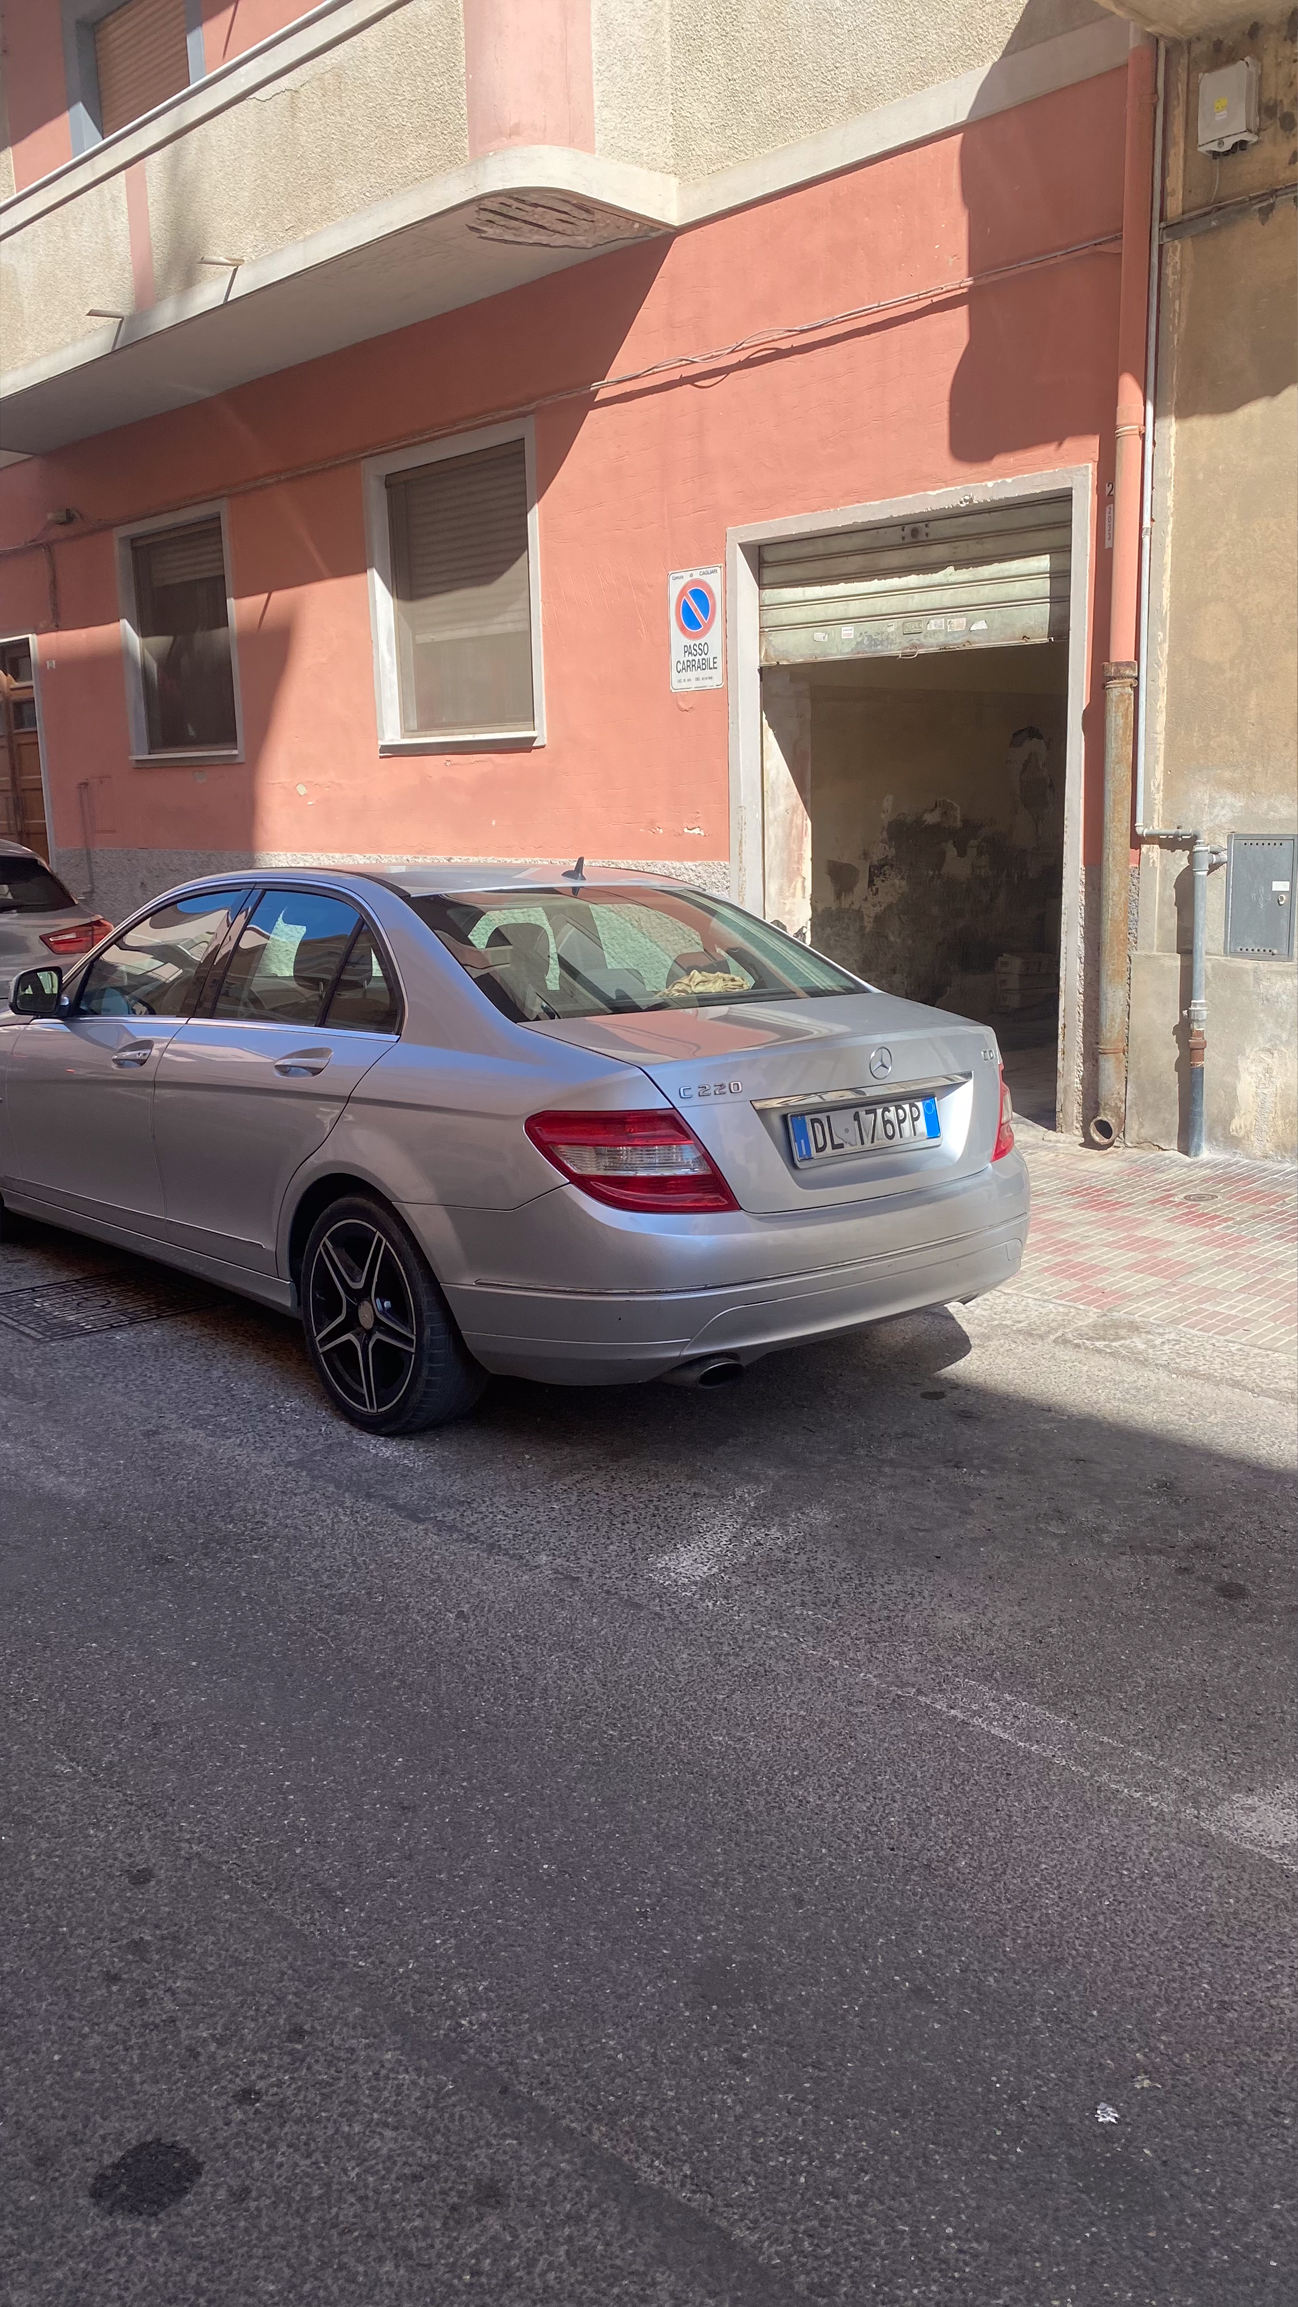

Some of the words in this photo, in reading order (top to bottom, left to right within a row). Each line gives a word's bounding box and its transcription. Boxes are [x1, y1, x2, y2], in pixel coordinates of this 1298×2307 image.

[1107, 482, 1114, 497] 2
[683, 642, 709, 657] PASSO
[675, 656, 718, 674] CARRABILE
[679, 1085, 693, 1099] C
[697, 1081, 743, 1097] 220
[810, 1115, 845, 1154] DL
[853, 1103, 921, 1146] 176PP
